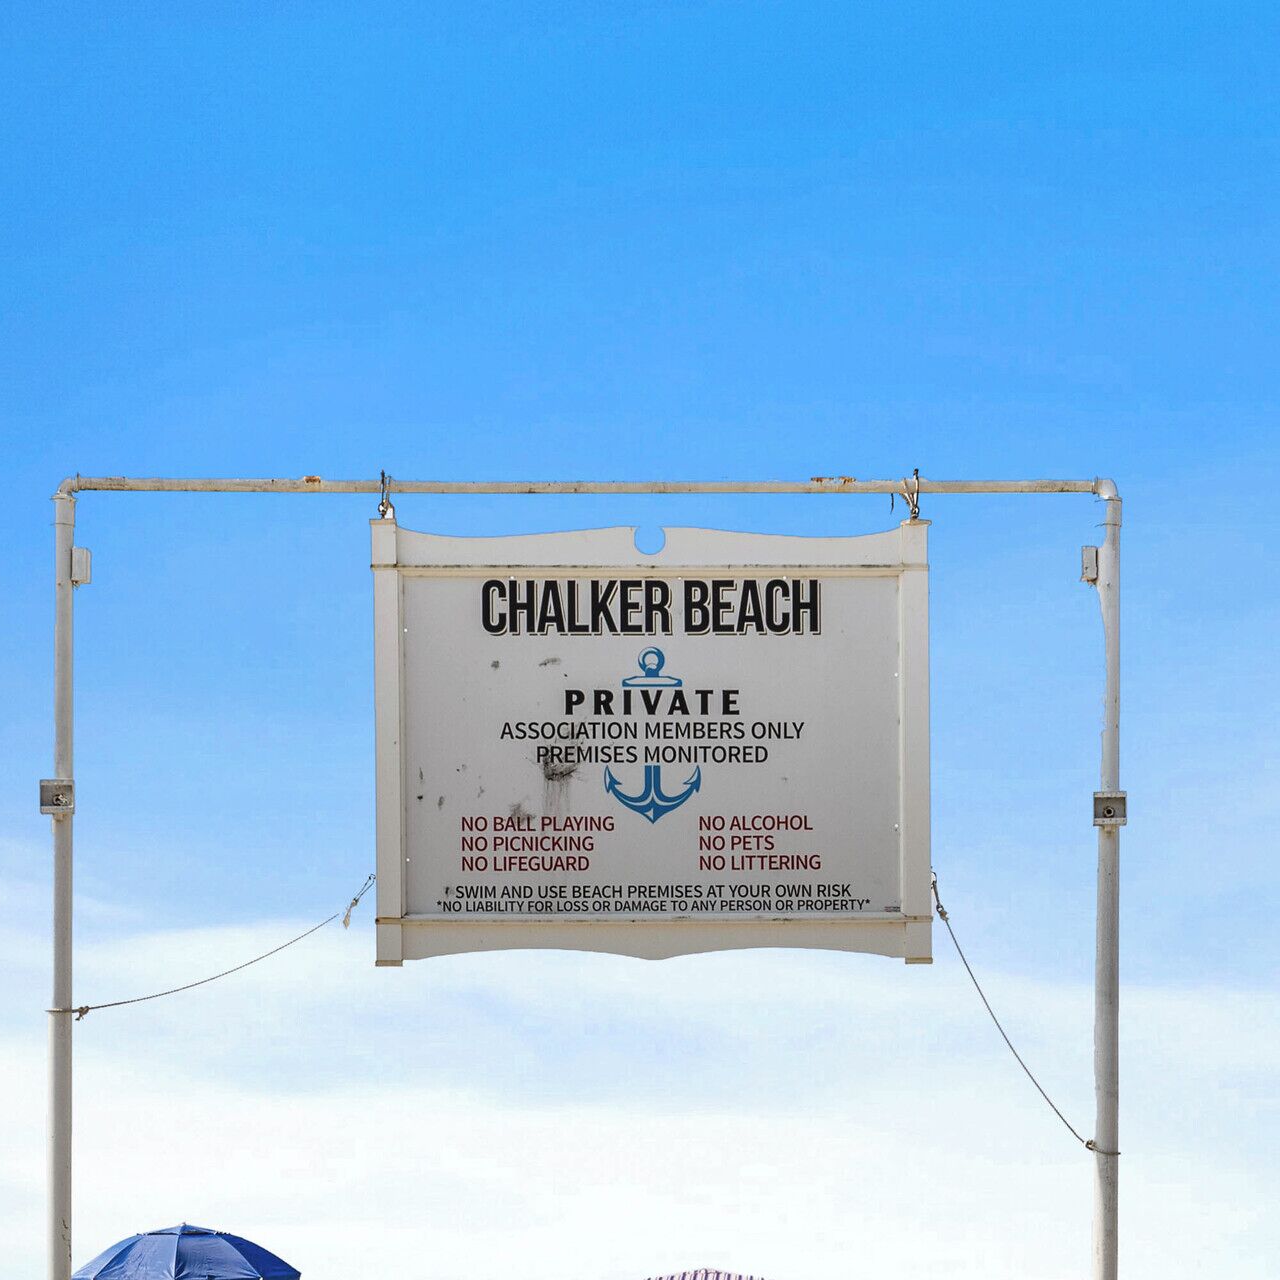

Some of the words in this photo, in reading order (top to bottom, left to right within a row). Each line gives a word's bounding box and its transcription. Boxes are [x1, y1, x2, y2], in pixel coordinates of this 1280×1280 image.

[481, 578, 672, 636] CHALKER
[684, 578, 822, 636] BEACH
[564, 689, 740, 715] PRIVATE
[500, 722, 638, 740] ASSOCIATION
[644, 722, 746, 740] MEMBERS
[751, 721, 805, 740] ONLY
[536, 746, 638, 763] PREMISES
[644, 746, 769, 764] MONITORED
[461, 816, 488, 832] NO
[493, 816, 536, 832] BALL
[541, 816, 615, 832] PLAYING
[699, 815, 726, 831] NO
[729, 815, 814, 831] ALCOHOL
[461, 836, 488, 852] NO
[493, 836, 595, 852] PICNICKING
[699, 835, 726, 851] NO
[730, 835, 775, 851] PETS
[461, 856, 488, 872] NO
[493, 856, 590, 872] LIFEGUARD
[699, 855, 726, 871] NO
[730, 854, 821, 871] LITTERING
[500, 885, 534, 899] AND
[538, 885, 568, 899] USE
[571, 885, 623, 899] BEACH
[627, 885, 703, 899] PREMISES
[706, 885, 726, 899] AT
[728, 884, 772, 898] YOUR
[775, 884, 813, 898] OWN
[816, 884, 852, 898] RISK
[465, 900, 524, 912] LIABILITY
[527, 900, 554, 912] FOR
[556, 900, 589, 912] LOSS
[592, 900, 611, 912] OR
[619, 900, 667, 912] DAMAGE
[670, 899, 688, 911] TO
[691, 899, 718, 911] ANY
[720, 899, 772, 911] PERSON
[775, 899, 794, 911] OR
